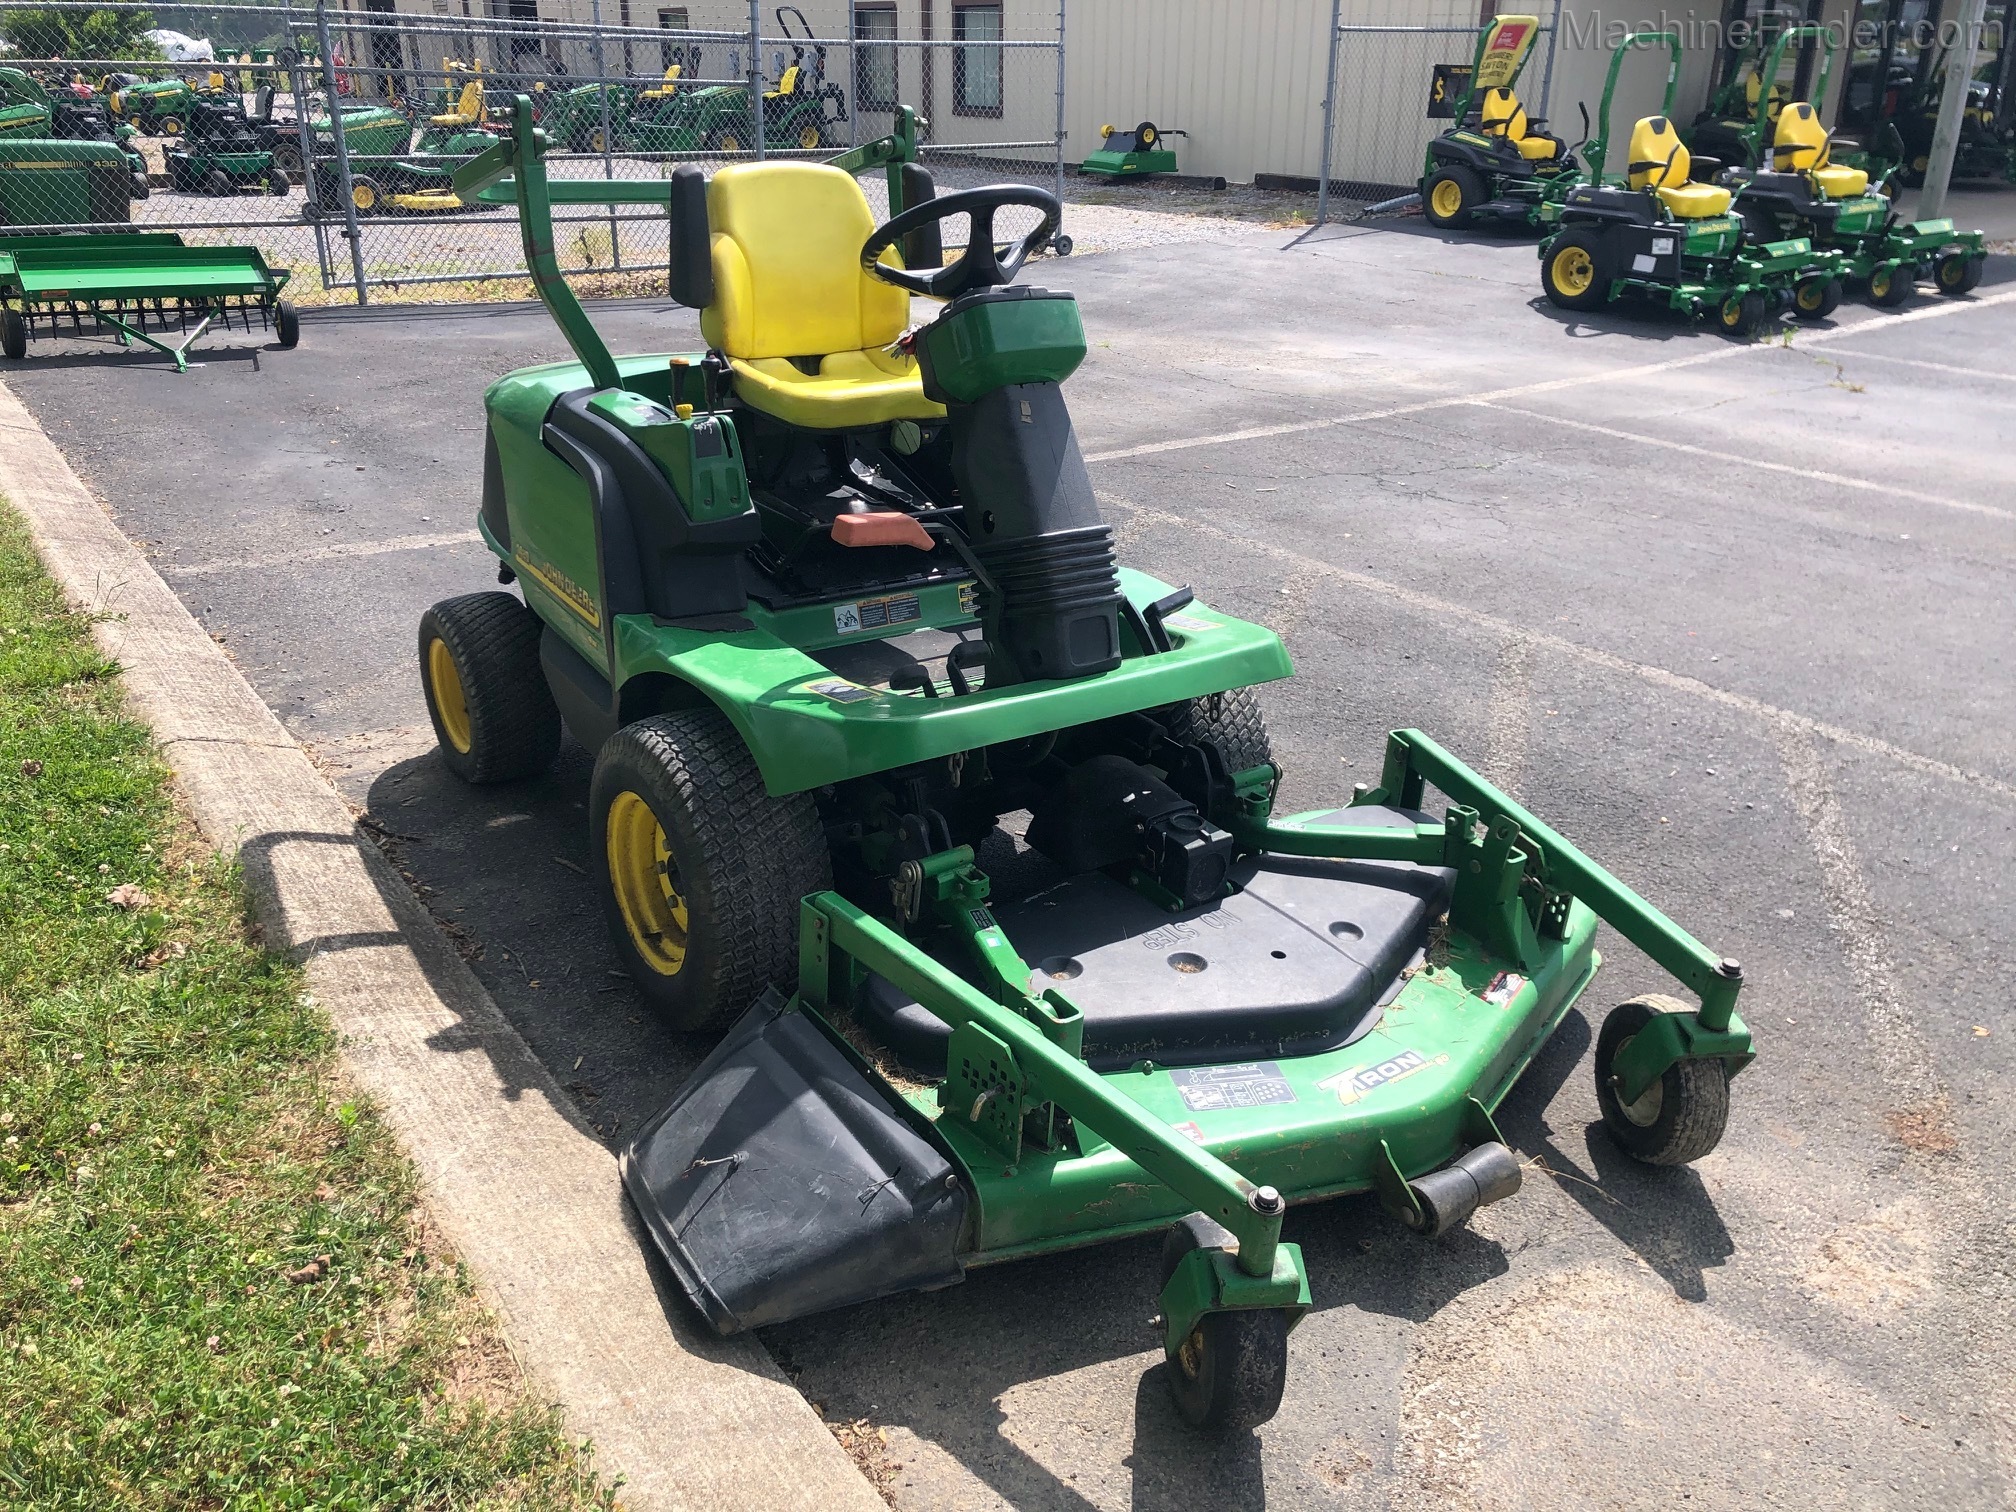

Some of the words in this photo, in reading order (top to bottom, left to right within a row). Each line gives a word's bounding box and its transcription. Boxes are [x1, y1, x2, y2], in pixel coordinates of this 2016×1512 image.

[94, 160, 118, 168] 430
[1696, 224, 1713, 234] JOHN
[1712, 222, 1732, 232] DEERE
[1200, 908, 1243, 929] NO
[1142, 922, 1200, 950] STEP
